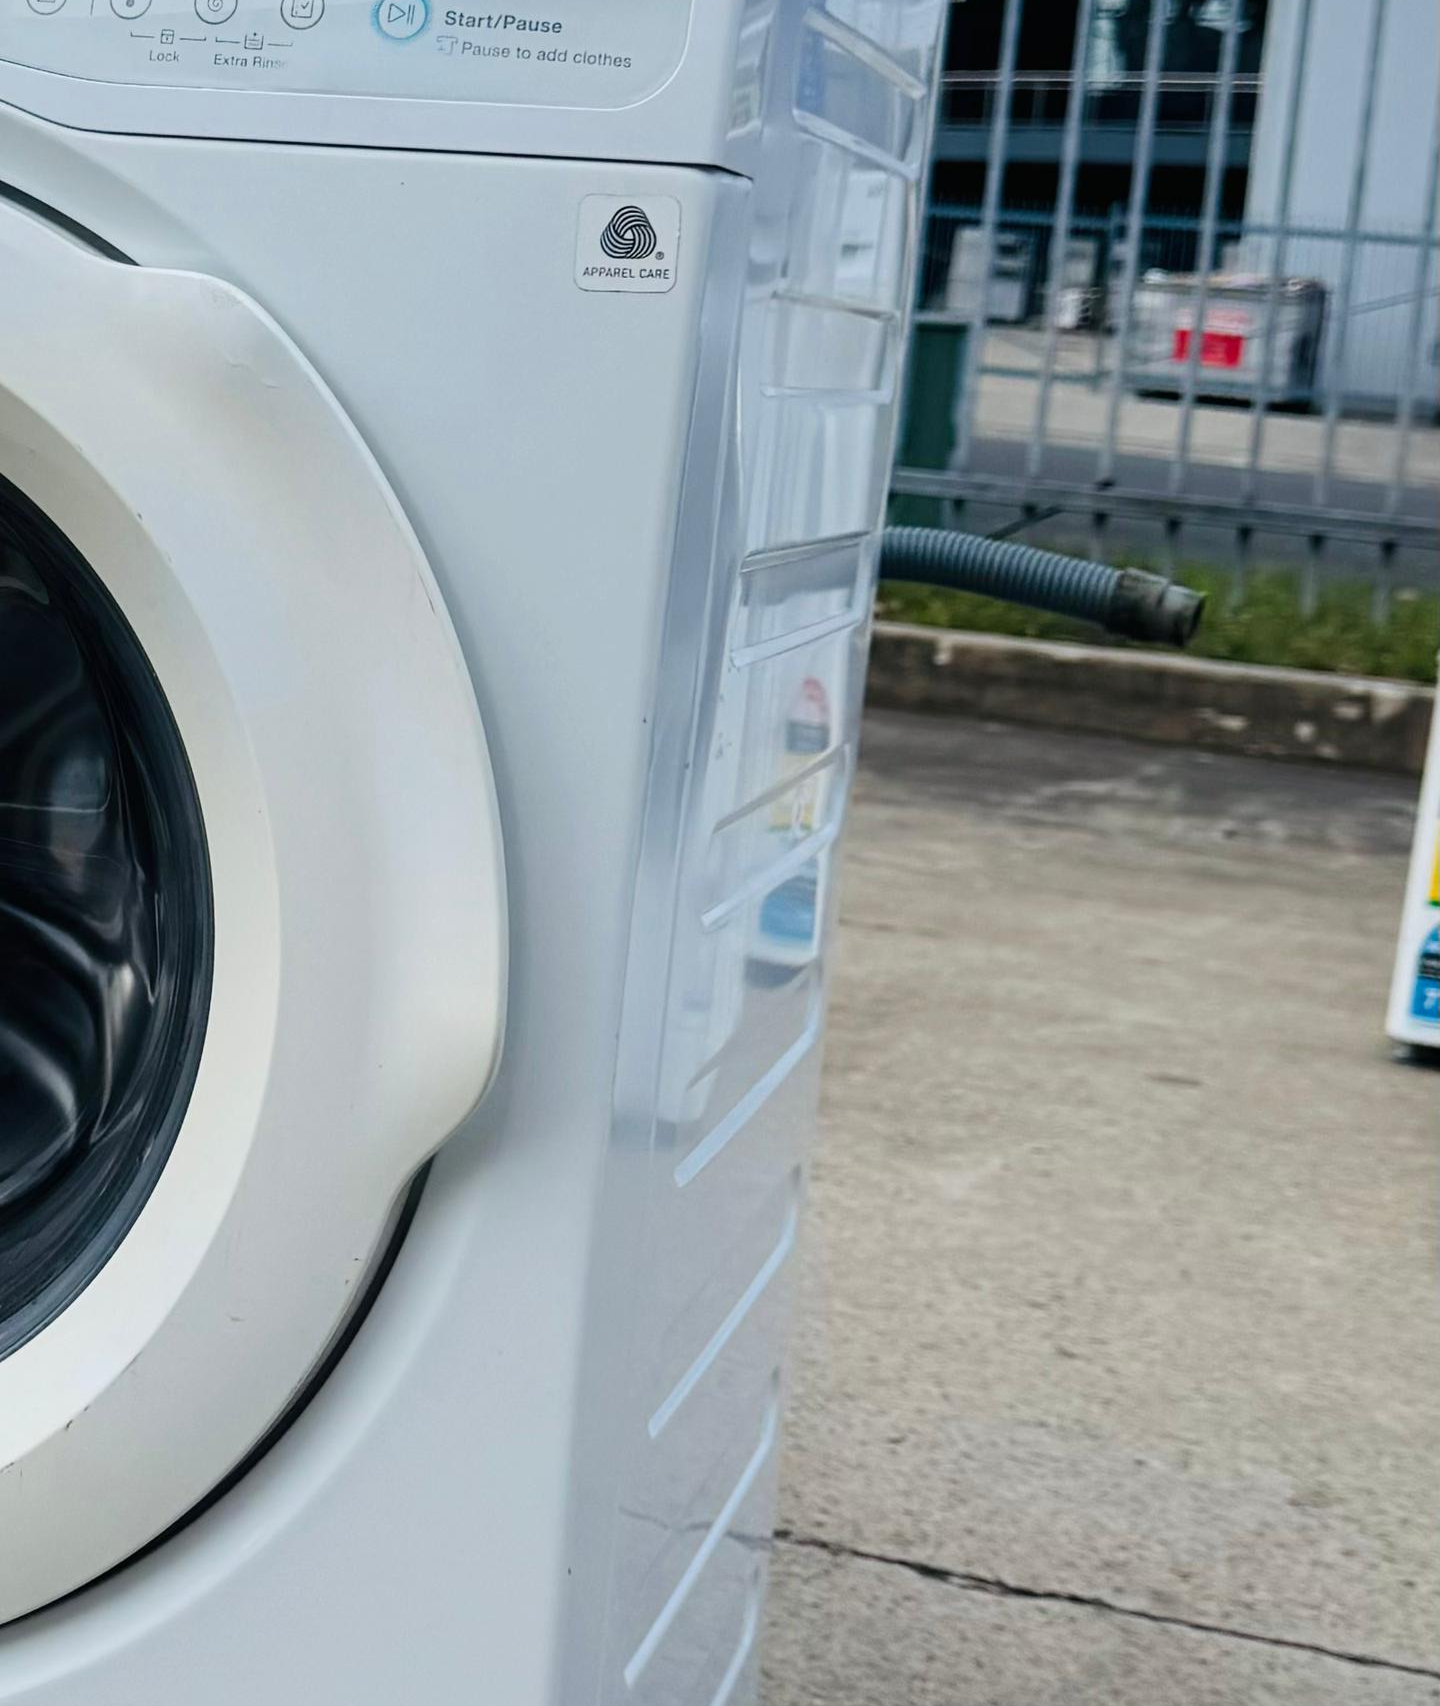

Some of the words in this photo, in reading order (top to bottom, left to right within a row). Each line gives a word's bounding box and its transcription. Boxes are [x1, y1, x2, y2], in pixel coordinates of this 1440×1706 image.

[444, 10, 563, 33] Start/Pause
[149, 49, 180, 62] Lock
[214, 53, 248, 68] Extra
[461, 41, 510, 58] Pause
[516, 47, 531, 60] to
[536, 47, 568, 63] add
[572, 50, 632, 68] clothes
[582, 266, 636, 279] APPAREL
[639, 268, 670, 280] CARE
